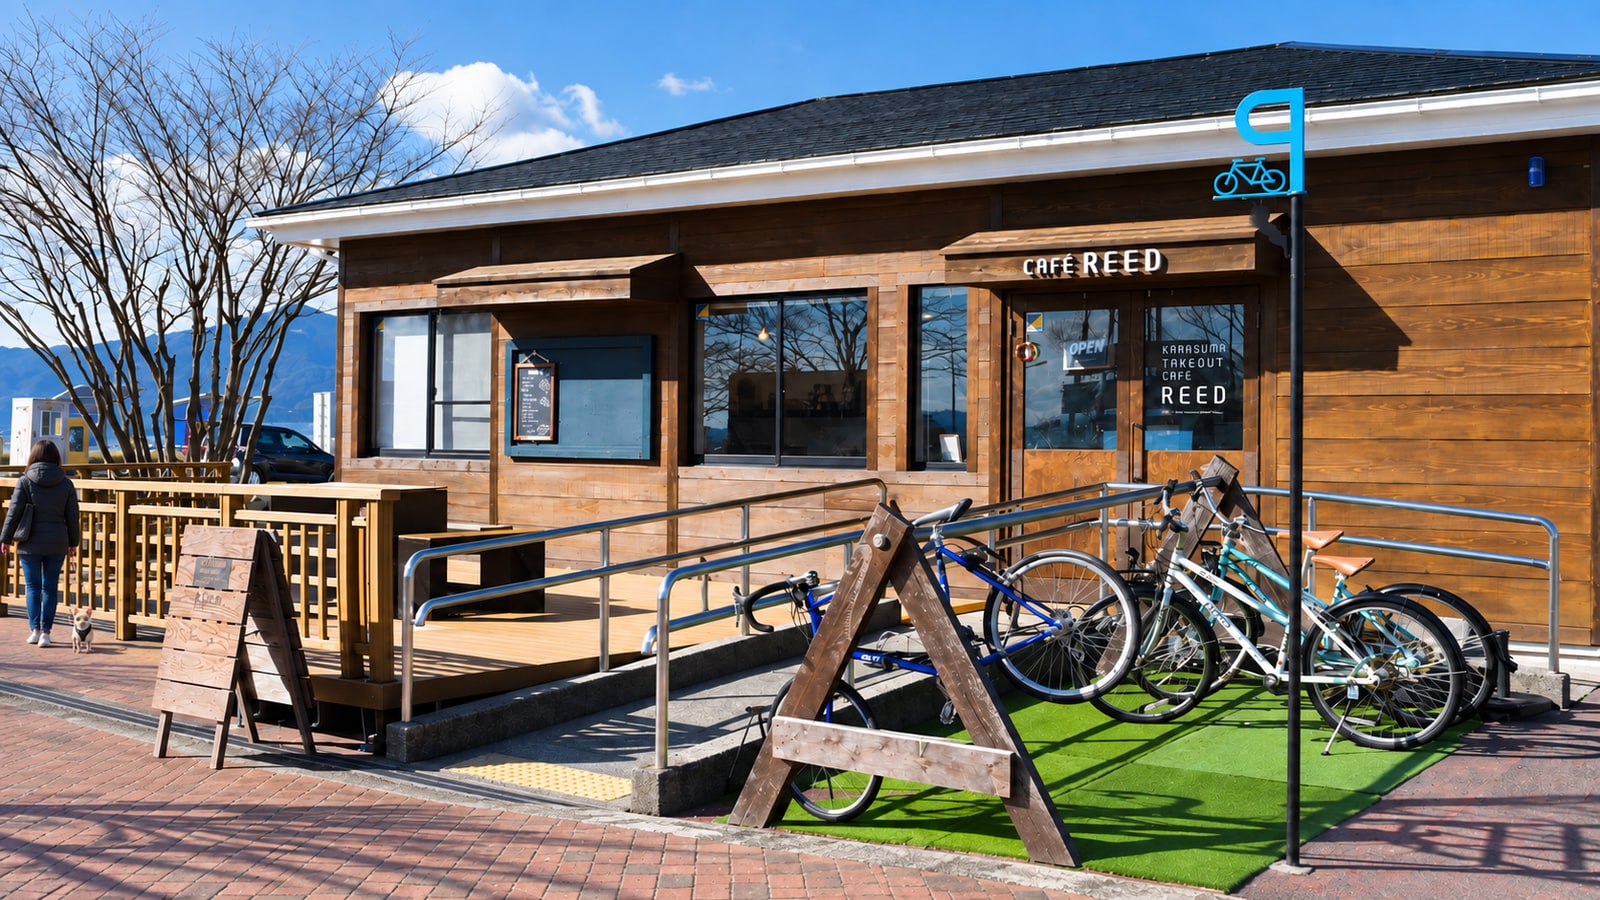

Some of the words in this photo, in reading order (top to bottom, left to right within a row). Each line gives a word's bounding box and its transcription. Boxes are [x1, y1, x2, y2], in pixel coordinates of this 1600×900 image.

[1023, 253, 1074, 275] CAFÉ
[1083, 248, 1161, 274] REED
[1070, 339, 1105, 355] OPEN
[1162, 343, 1226, 355] KARASUMA
[1162, 357, 1224, 369] TAKEOUT
[1161, 385, 1226, 405] REED
